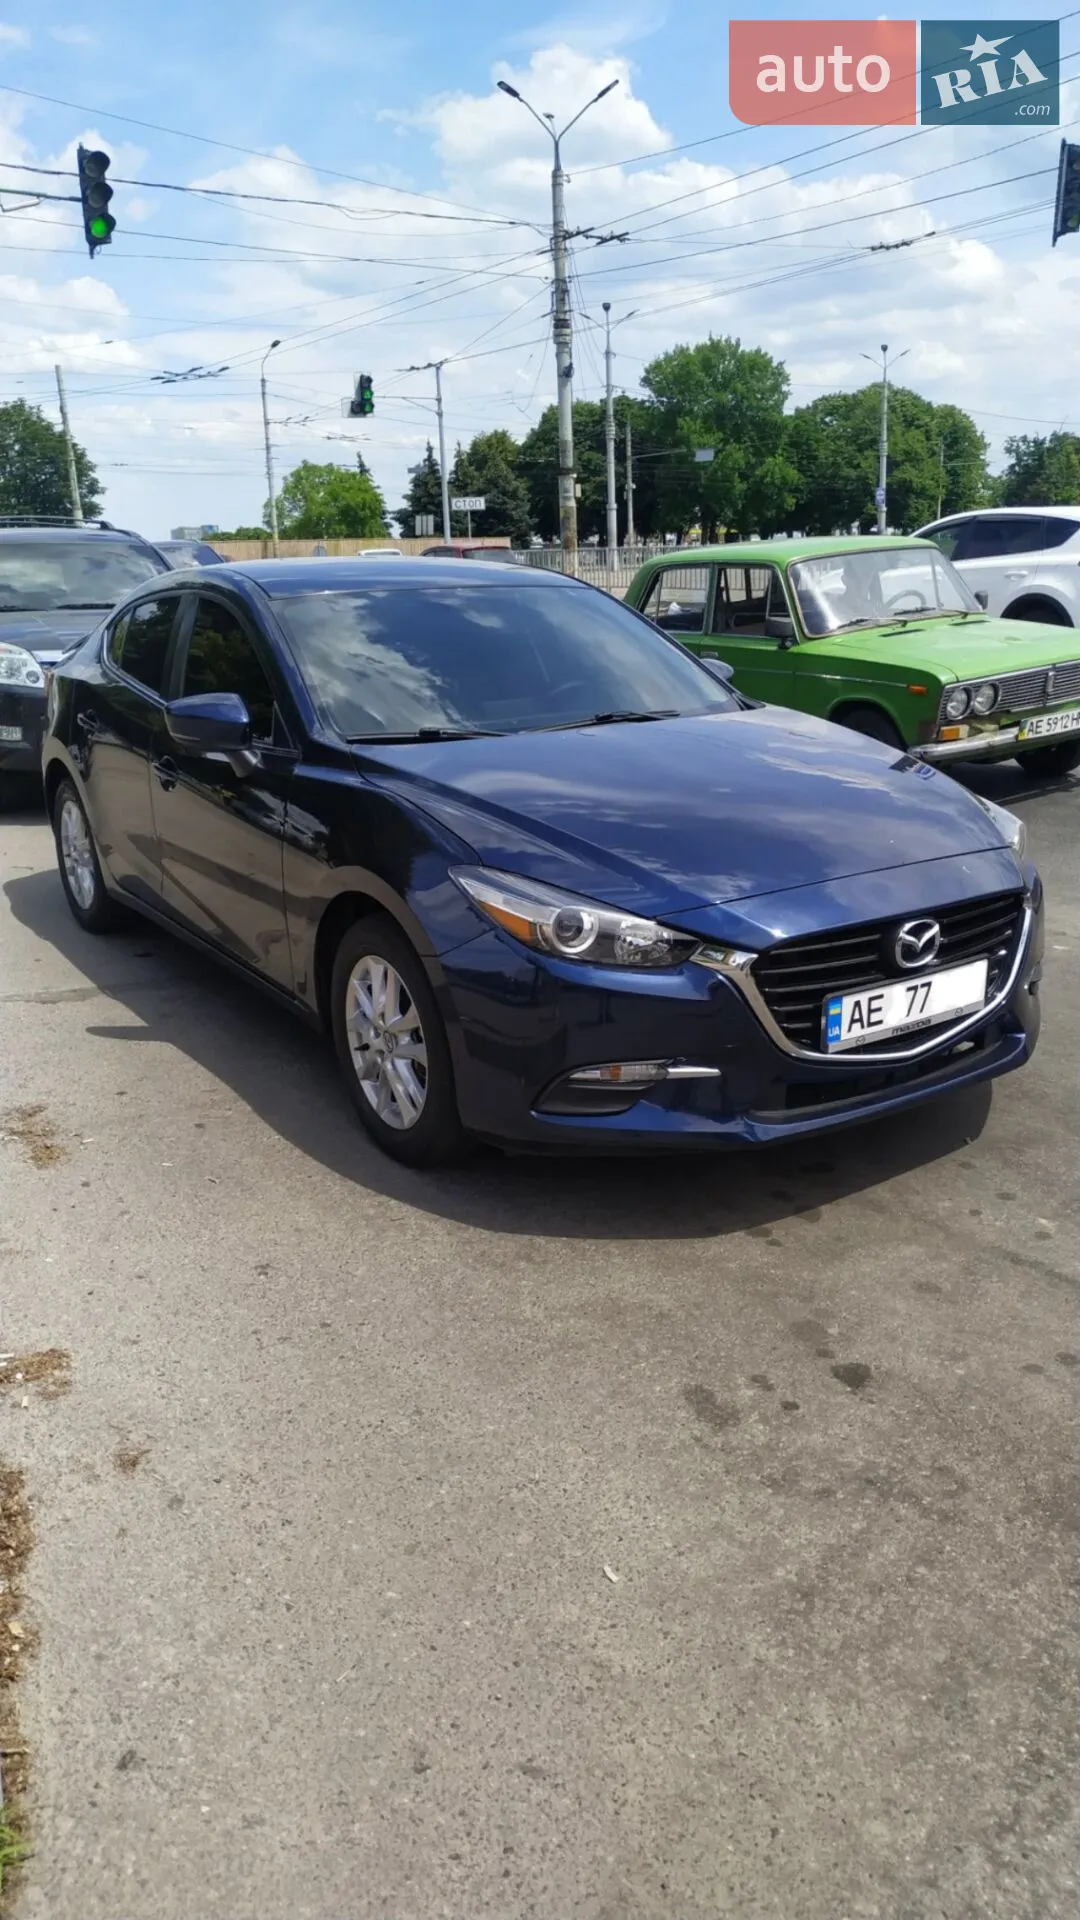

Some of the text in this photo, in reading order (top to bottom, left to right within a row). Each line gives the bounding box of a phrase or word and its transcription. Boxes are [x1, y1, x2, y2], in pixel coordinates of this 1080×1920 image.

[1028, 711, 1080, 737] AE 5912 H
[847, 981, 933, 1033] AE 77
[828, 1025, 841, 1037] UA
